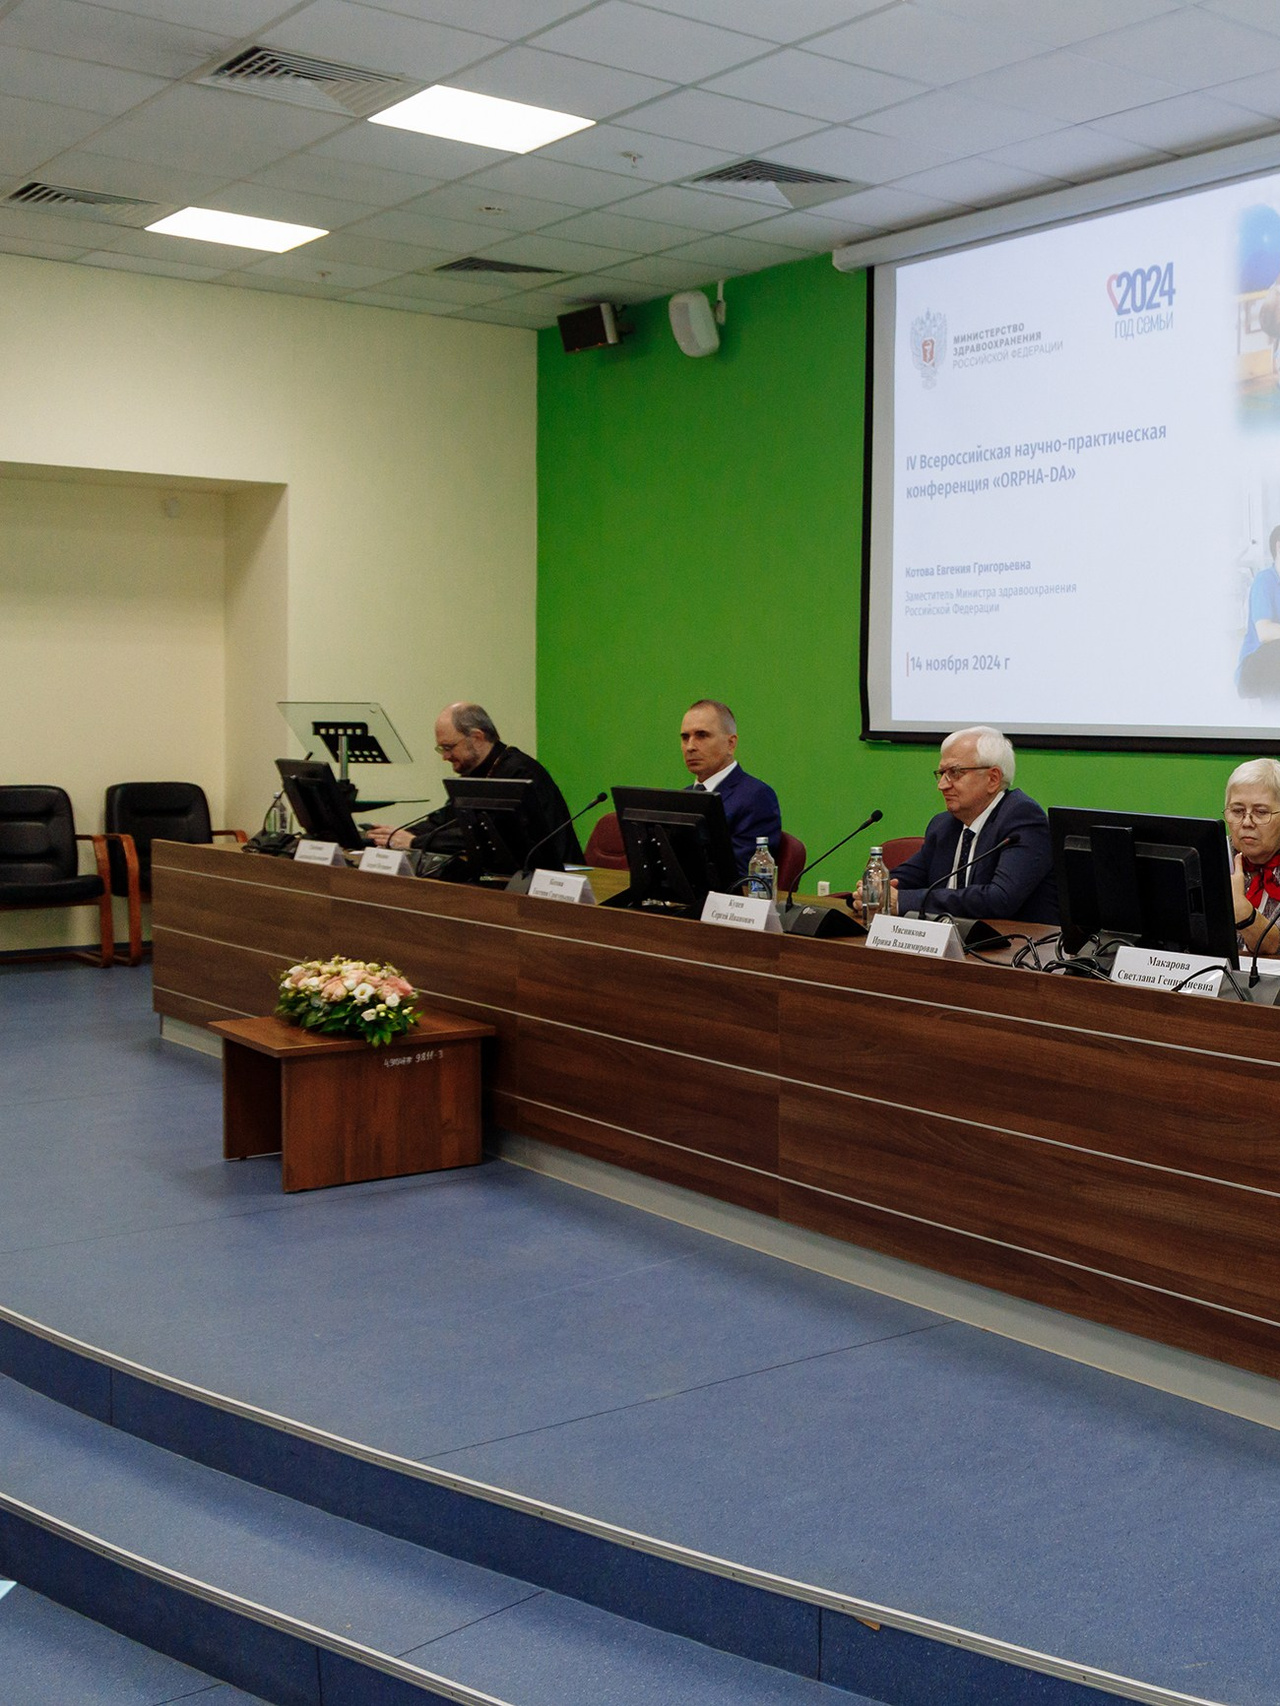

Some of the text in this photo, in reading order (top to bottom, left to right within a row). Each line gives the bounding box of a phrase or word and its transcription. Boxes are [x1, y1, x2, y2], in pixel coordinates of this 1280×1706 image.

[1116, 262, 1176, 316] 2024
[952, 322, 1025, 345] МИНИСТЕРСТВО
[1114, 318, 1135, 340] ГОД
[952, 331, 1042, 357] ЗДРАВООХРАНЕНИЯ
[952, 340, 1064, 369] РОССИЙСКОЙ ФЕДЕРАЦИИ
[906, 425, 1167, 471] IV Всероссийская научно-практическая
[905, 465, 1077, 500] конференция «ORPHA-DA»
[905, 560, 1031, 578] Котова Евгения Григорьевна
[905, 583, 1077, 602] Заместитель Министра здравоохранения
[905, 602, 1000, 616] Российской Федерации
[910, 654, 1011, 675] 14 ноября 2024 г
[1147, 956, 1191, 971] Макарова
[1117, 969, 1156, 984] Светлана
